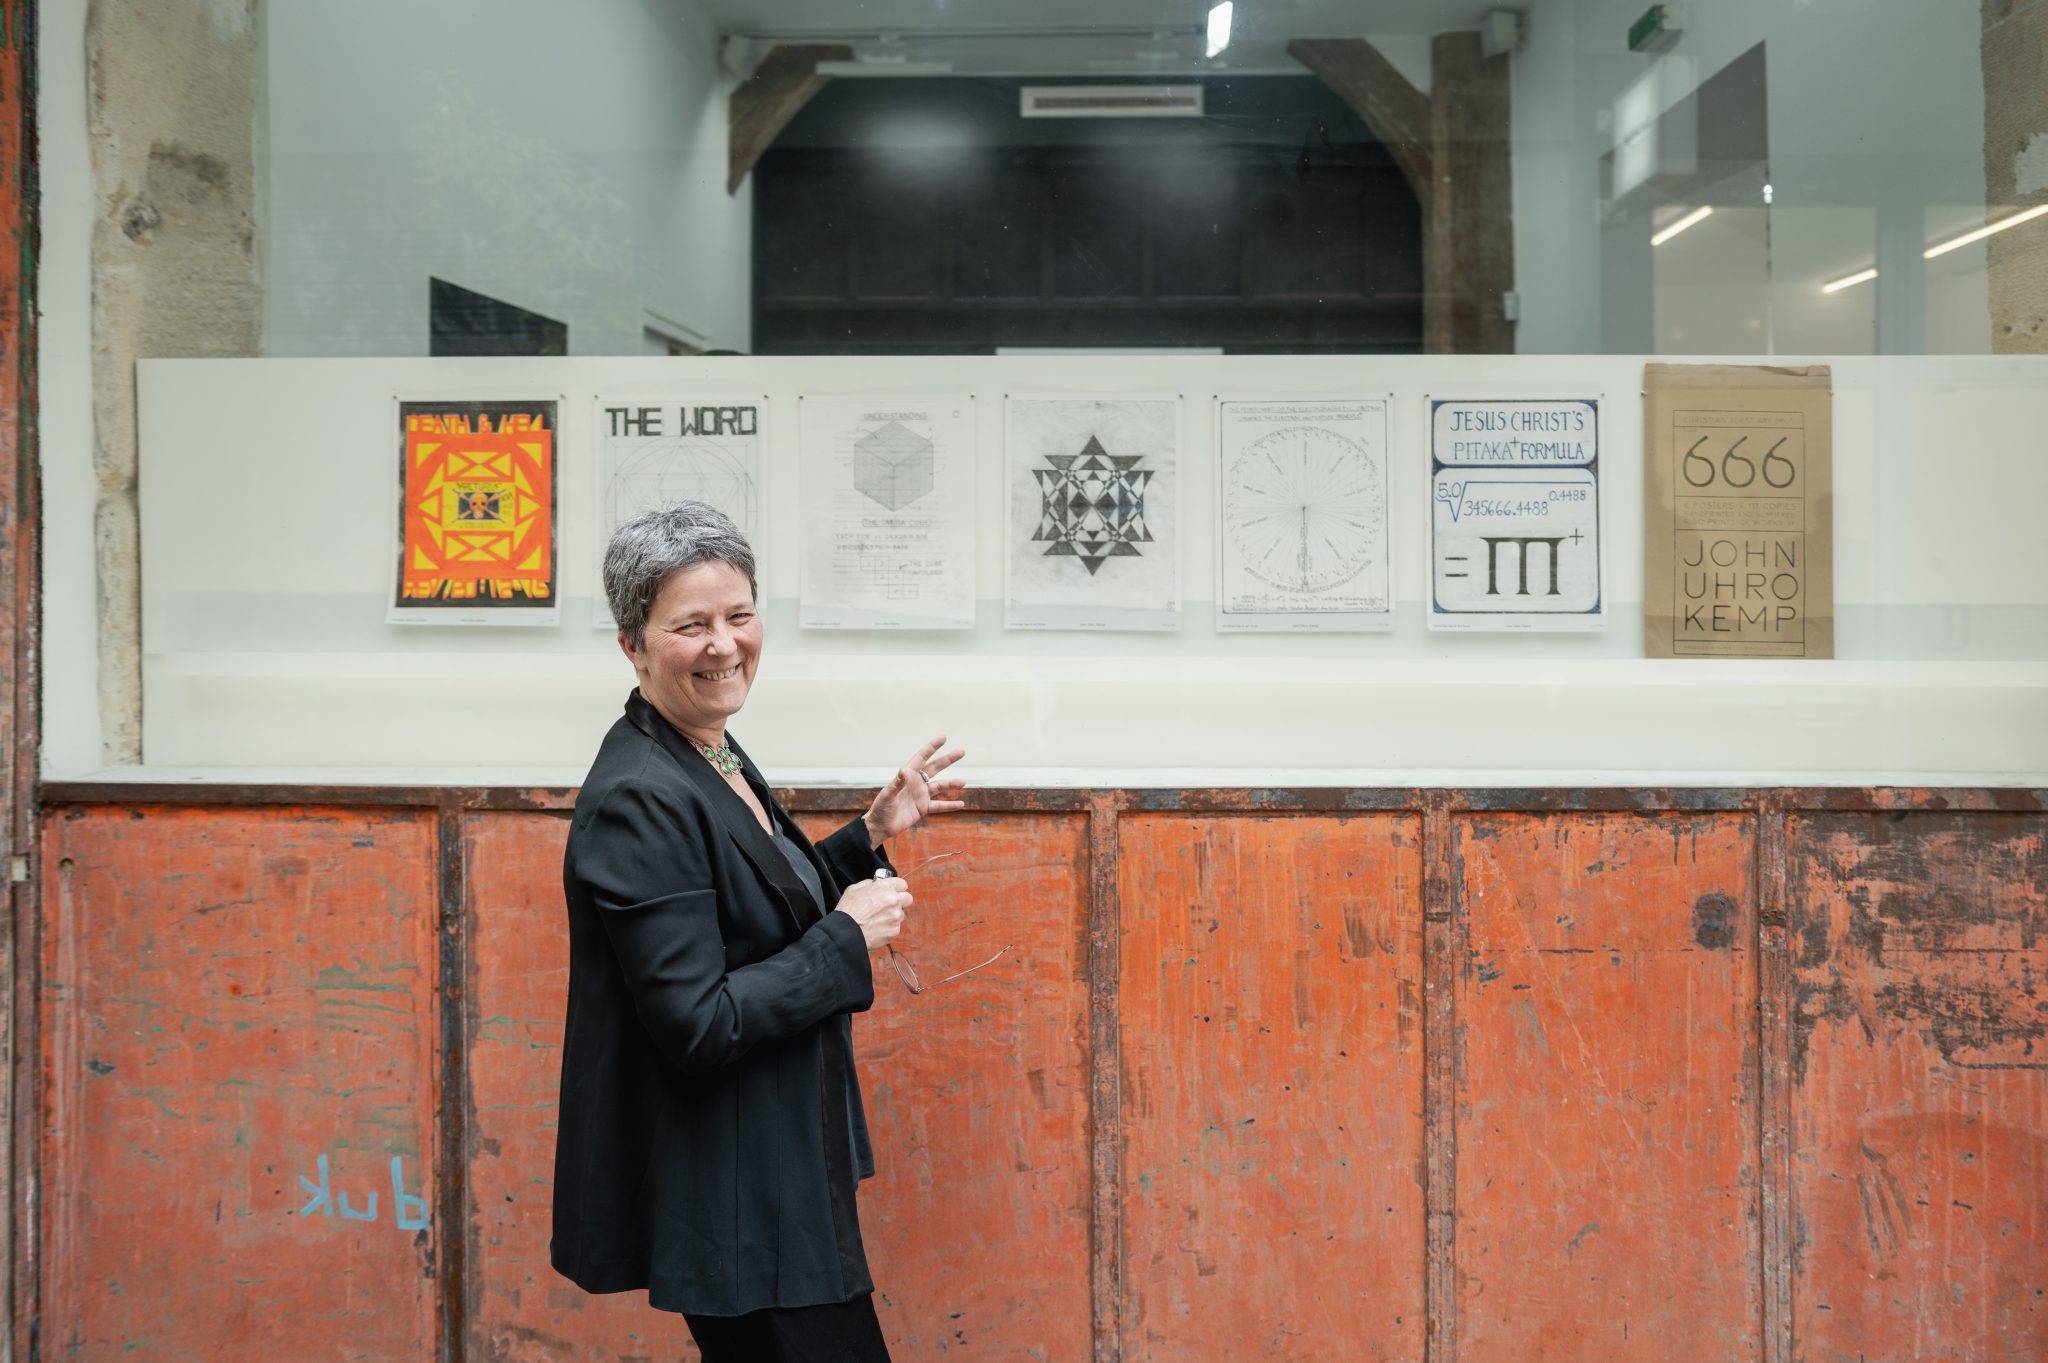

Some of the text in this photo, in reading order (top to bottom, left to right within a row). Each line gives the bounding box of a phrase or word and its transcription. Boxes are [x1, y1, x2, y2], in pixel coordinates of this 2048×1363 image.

[605, 406, 758, 437] THE WORD
[1450, 410, 1585, 431] JESUS CHRIST'S
[1520, 442, 1586, 460] FORMULA
[1682, 435, 1796, 489] 666
[1683, 540, 1796, 568] JOHN
[1684, 572, 1799, 600] UHRO
[1684, 604, 1797, 632] KEMP
